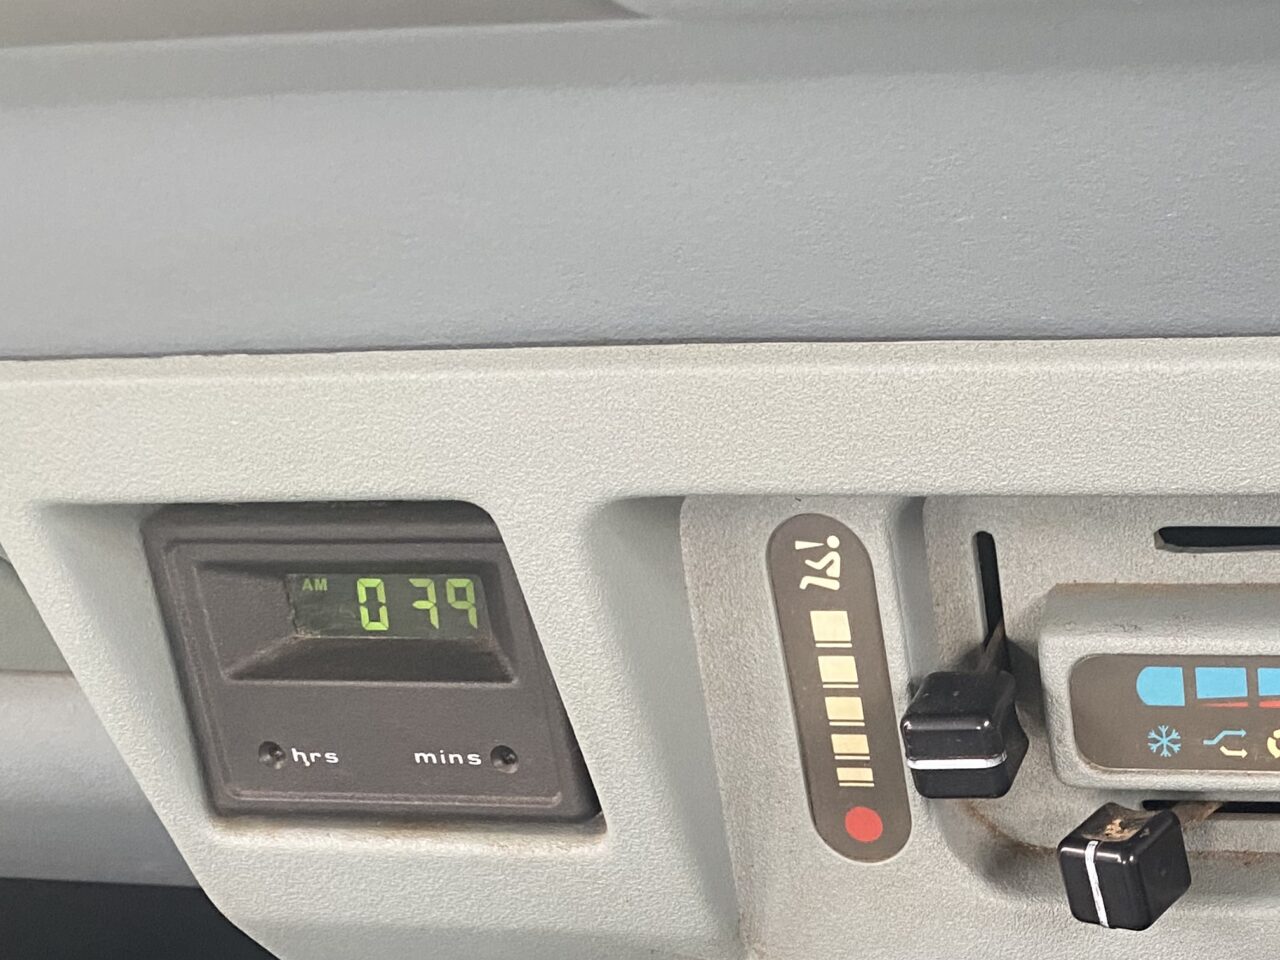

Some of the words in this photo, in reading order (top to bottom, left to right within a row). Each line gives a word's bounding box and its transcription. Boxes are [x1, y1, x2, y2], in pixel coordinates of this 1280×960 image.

[302, 577, 328, 592] AM
[291, 747, 339, 767] hrs
[414, 749, 482, 766] mins
